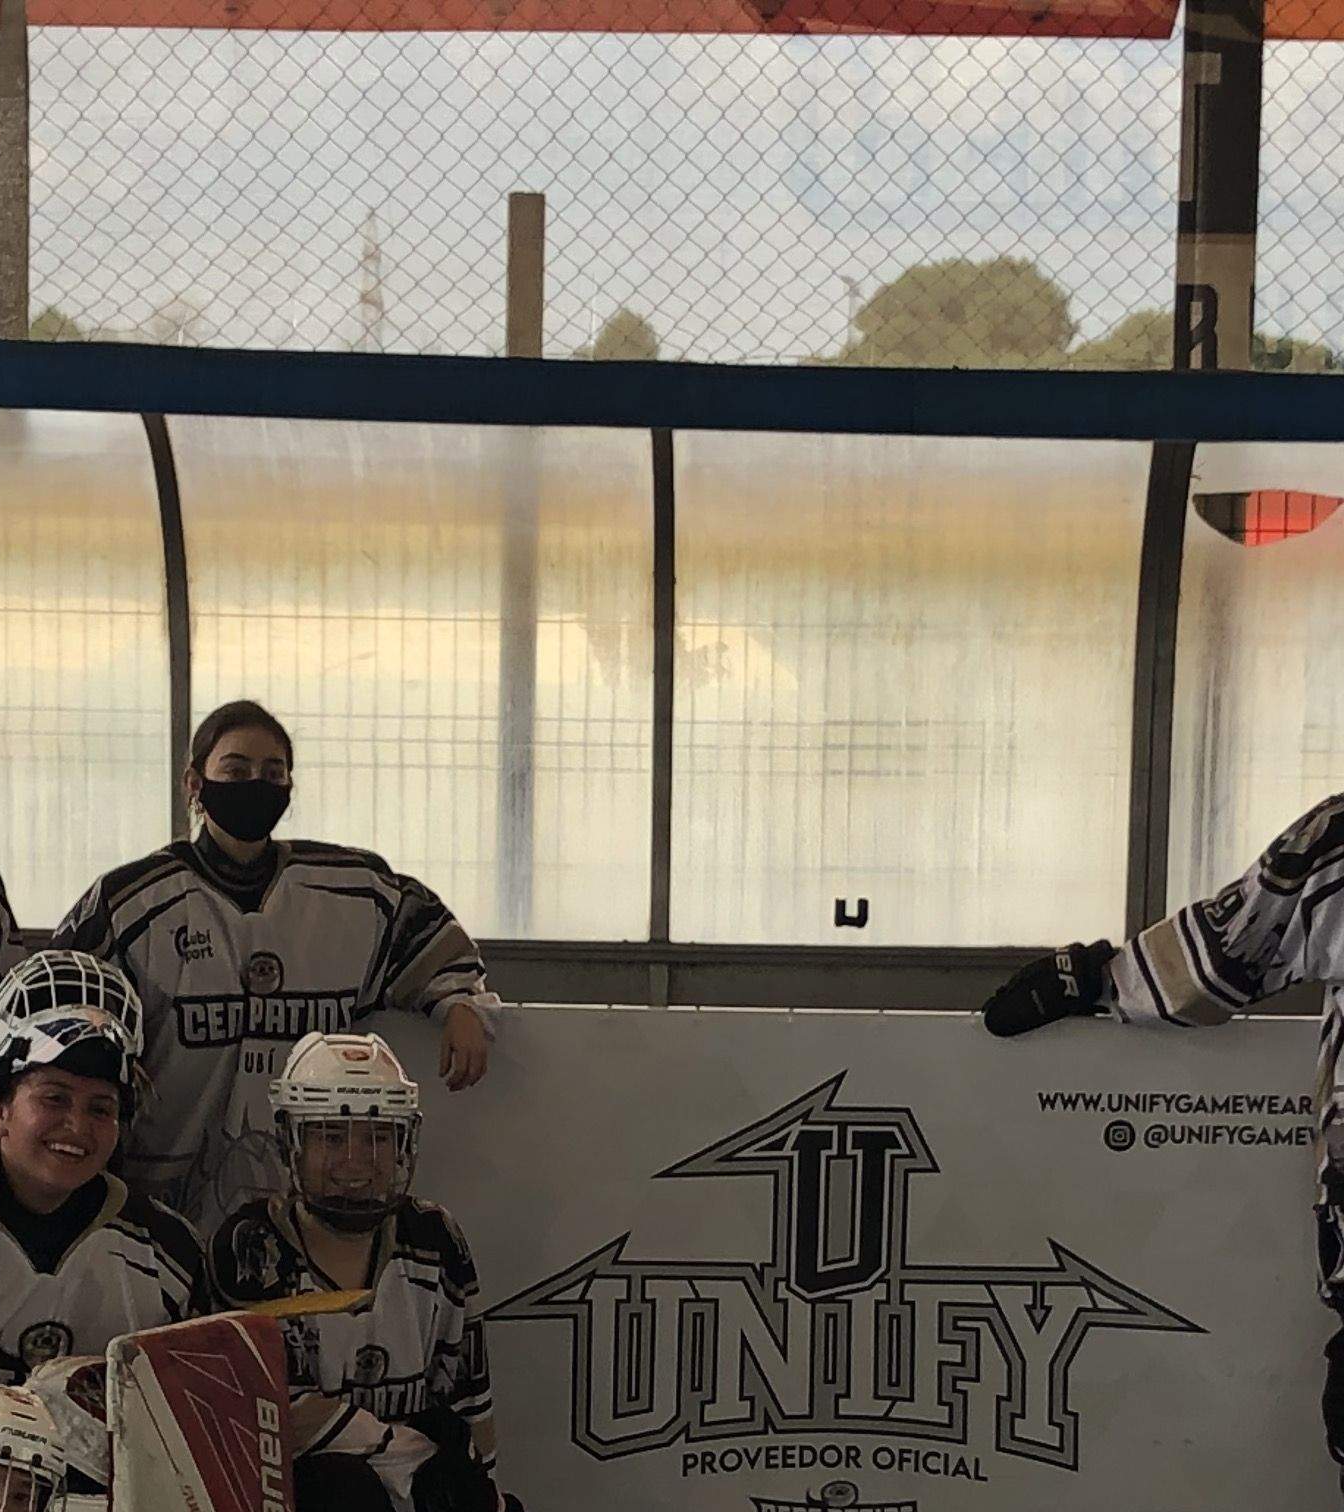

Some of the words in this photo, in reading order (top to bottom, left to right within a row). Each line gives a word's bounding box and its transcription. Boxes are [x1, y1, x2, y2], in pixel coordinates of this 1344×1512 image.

[572, 1272, 1102, 1471] UNIFY
[681, 1445, 863, 1478] PROVEEDOR
[871, 1446, 989, 1482] OFICIAL
